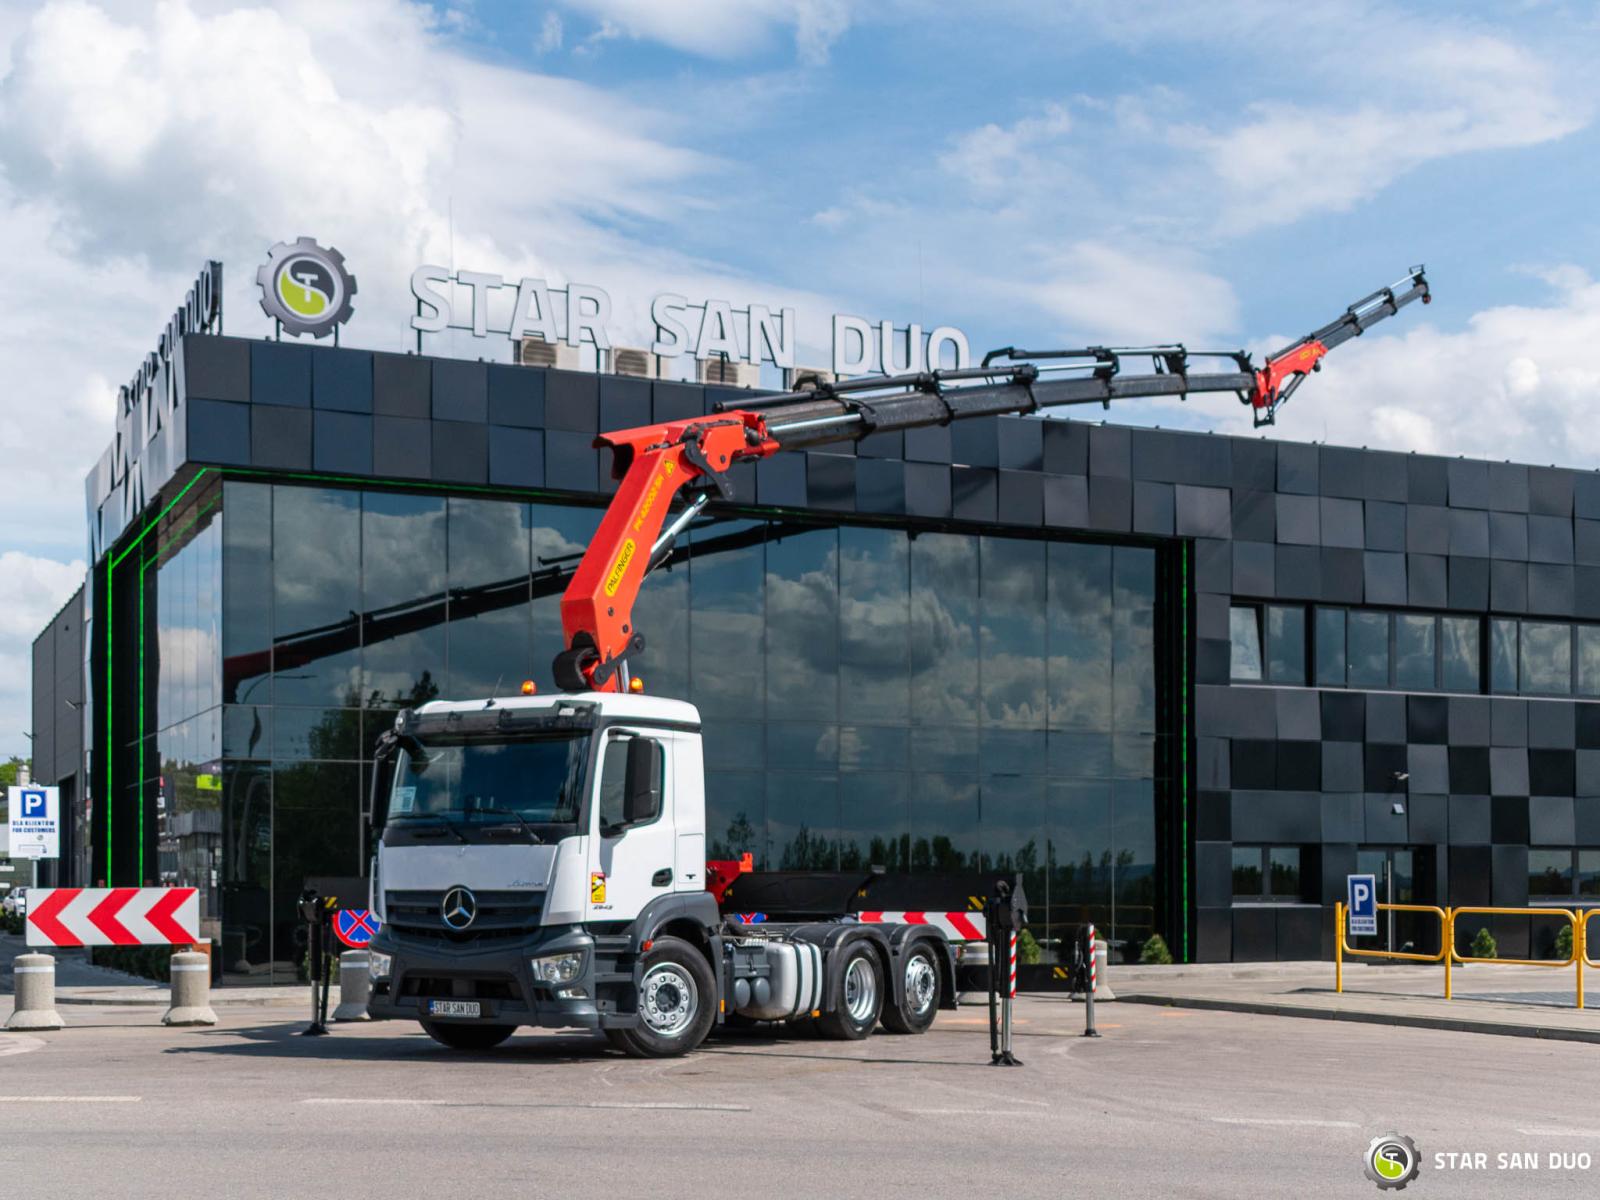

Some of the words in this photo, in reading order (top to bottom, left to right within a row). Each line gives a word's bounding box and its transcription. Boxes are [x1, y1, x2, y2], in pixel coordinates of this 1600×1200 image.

[410, 265, 612, 351] STAR
[651, 293, 795, 368] SAN
[832, 313, 970, 386] DUO
[607, 542, 634, 593] PALFINGER
[25, 793, 43, 815] P
[1354, 883, 1369, 912] P
[434, 1002, 451, 1015] STAR
[452, 1002, 466, 1015] SAN
[466, 1003, 480, 1016] DUO
